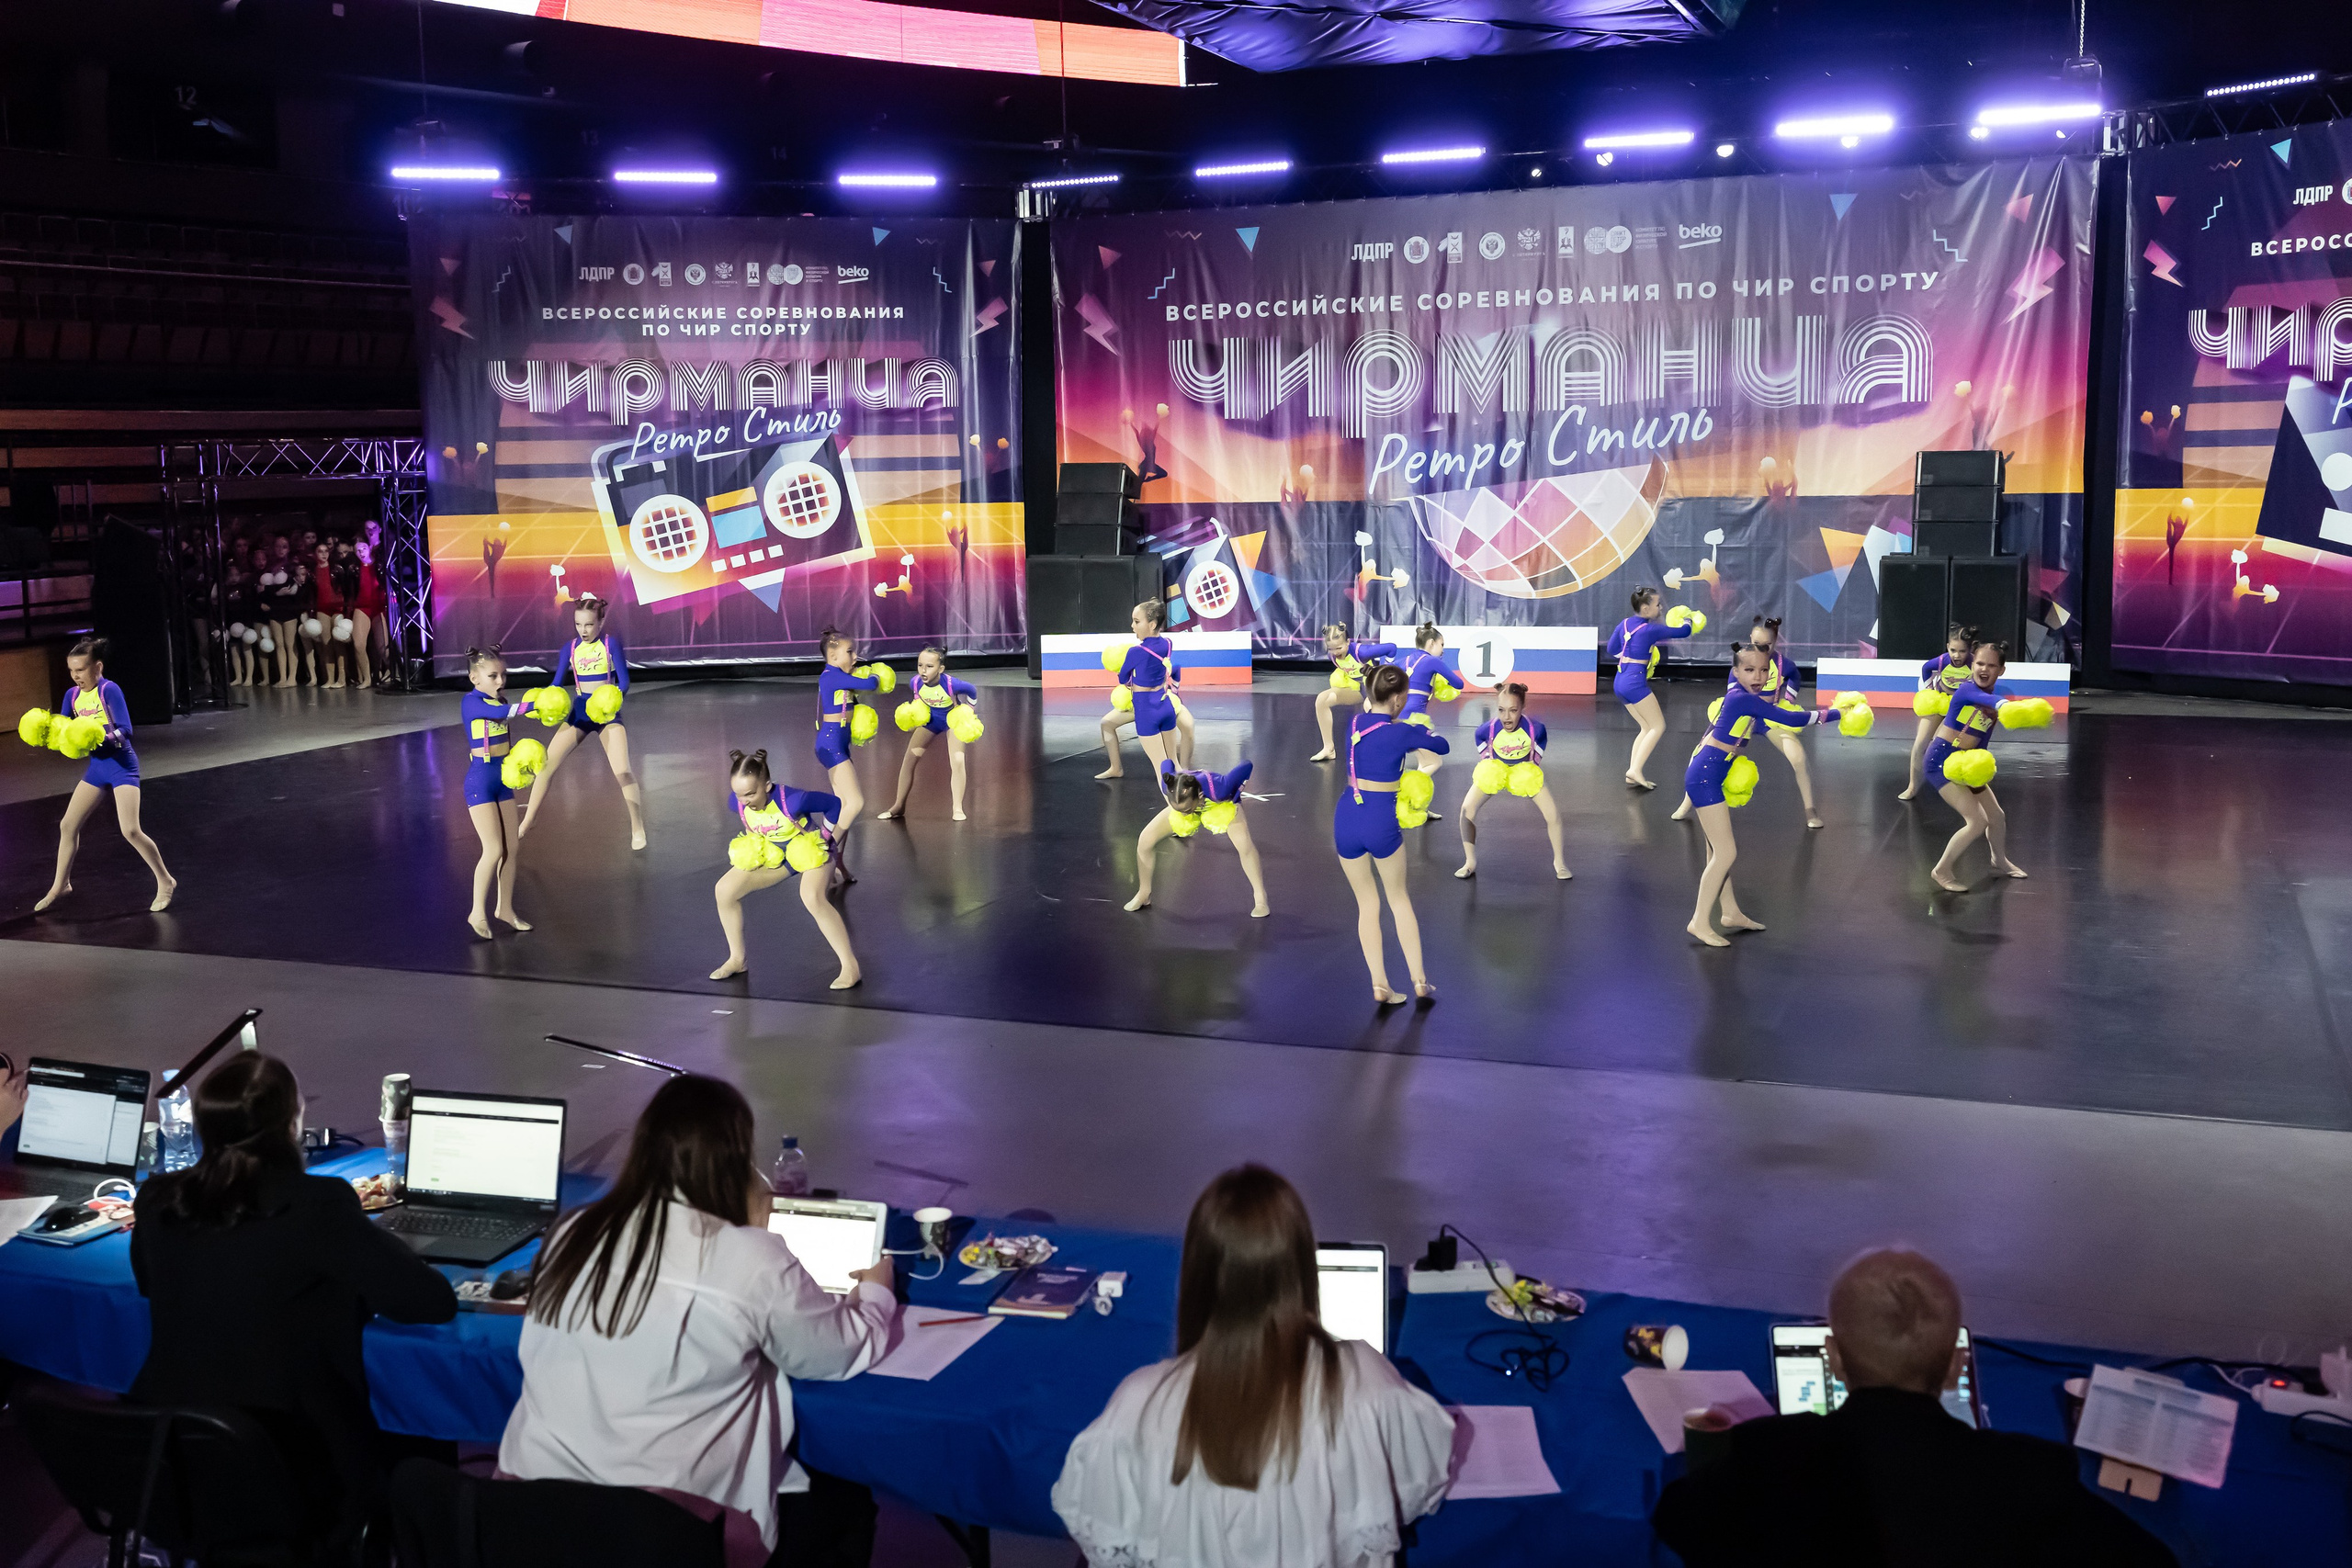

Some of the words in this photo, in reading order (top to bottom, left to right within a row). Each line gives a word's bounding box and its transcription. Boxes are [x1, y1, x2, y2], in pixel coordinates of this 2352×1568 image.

[174, 85, 198, 106] 12
[2292, 185, 2334, 207] ЛДПР
[1679, 222, 1723, 239] beko
[1351, 242, 1394, 263] ЛДПР
[578, 266, 615, 282] ЛДПР
[837, 265, 869, 277] beko
[1166, 294, 1405, 321] ВСЕРОССИЙСКИЕ
[1417, 283, 1659, 310] СОРЕВНОВАНИЯ
[1676, 281, 1717, 299] ПО
[1732, 277, 1794, 298] ЧИР
[1810, 271, 1939, 294] СПОРТУ
[542, 304, 727, 320] ВСЕРОССИЙСКИЕ
[736, 306, 904, 320] СОРЕВНОВАНИЯ
[642, 323, 670, 336] ПО
[679, 323, 721, 336] ЧИР
[730, 323, 811, 336] СПОРТУ
[630, 422, 731, 460] Ретро
[743, 406, 842, 443] Стиль
[1368, 433, 1526, 494] Ретро
[1548, 404, 1713, 467] Стиль
[1476, 640, 1497, 678] 1
